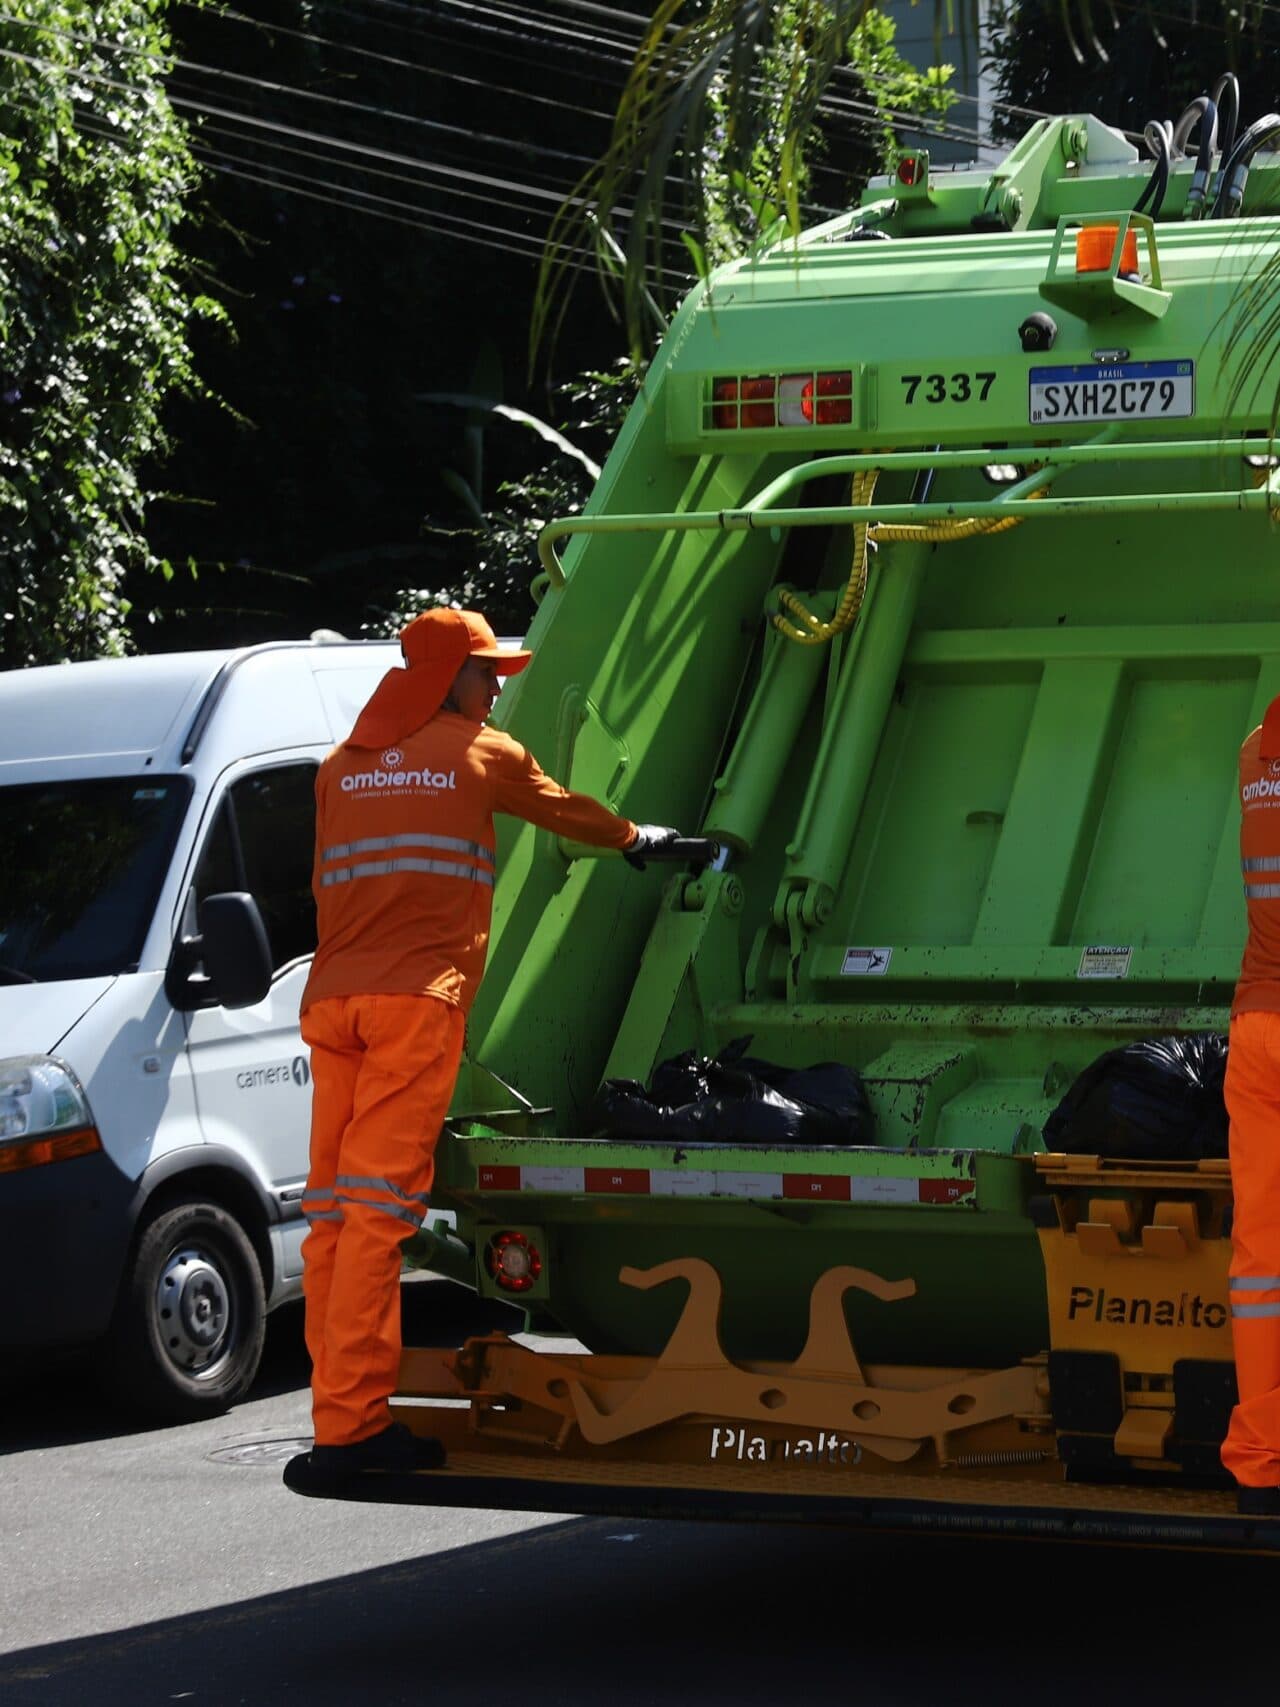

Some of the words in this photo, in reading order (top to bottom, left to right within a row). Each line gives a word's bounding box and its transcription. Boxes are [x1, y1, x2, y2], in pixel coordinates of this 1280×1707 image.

[901, 371, 997, 405] 7337
[1098, 369, 1124, 379] BRASIL
[1043, 380, 1175, 417] SXH2C79
[341, 768, 456, 792] ambiental
[236, 1065, 290, 1090] camera
[1068, 1286, 1227, 1329] Planalto
